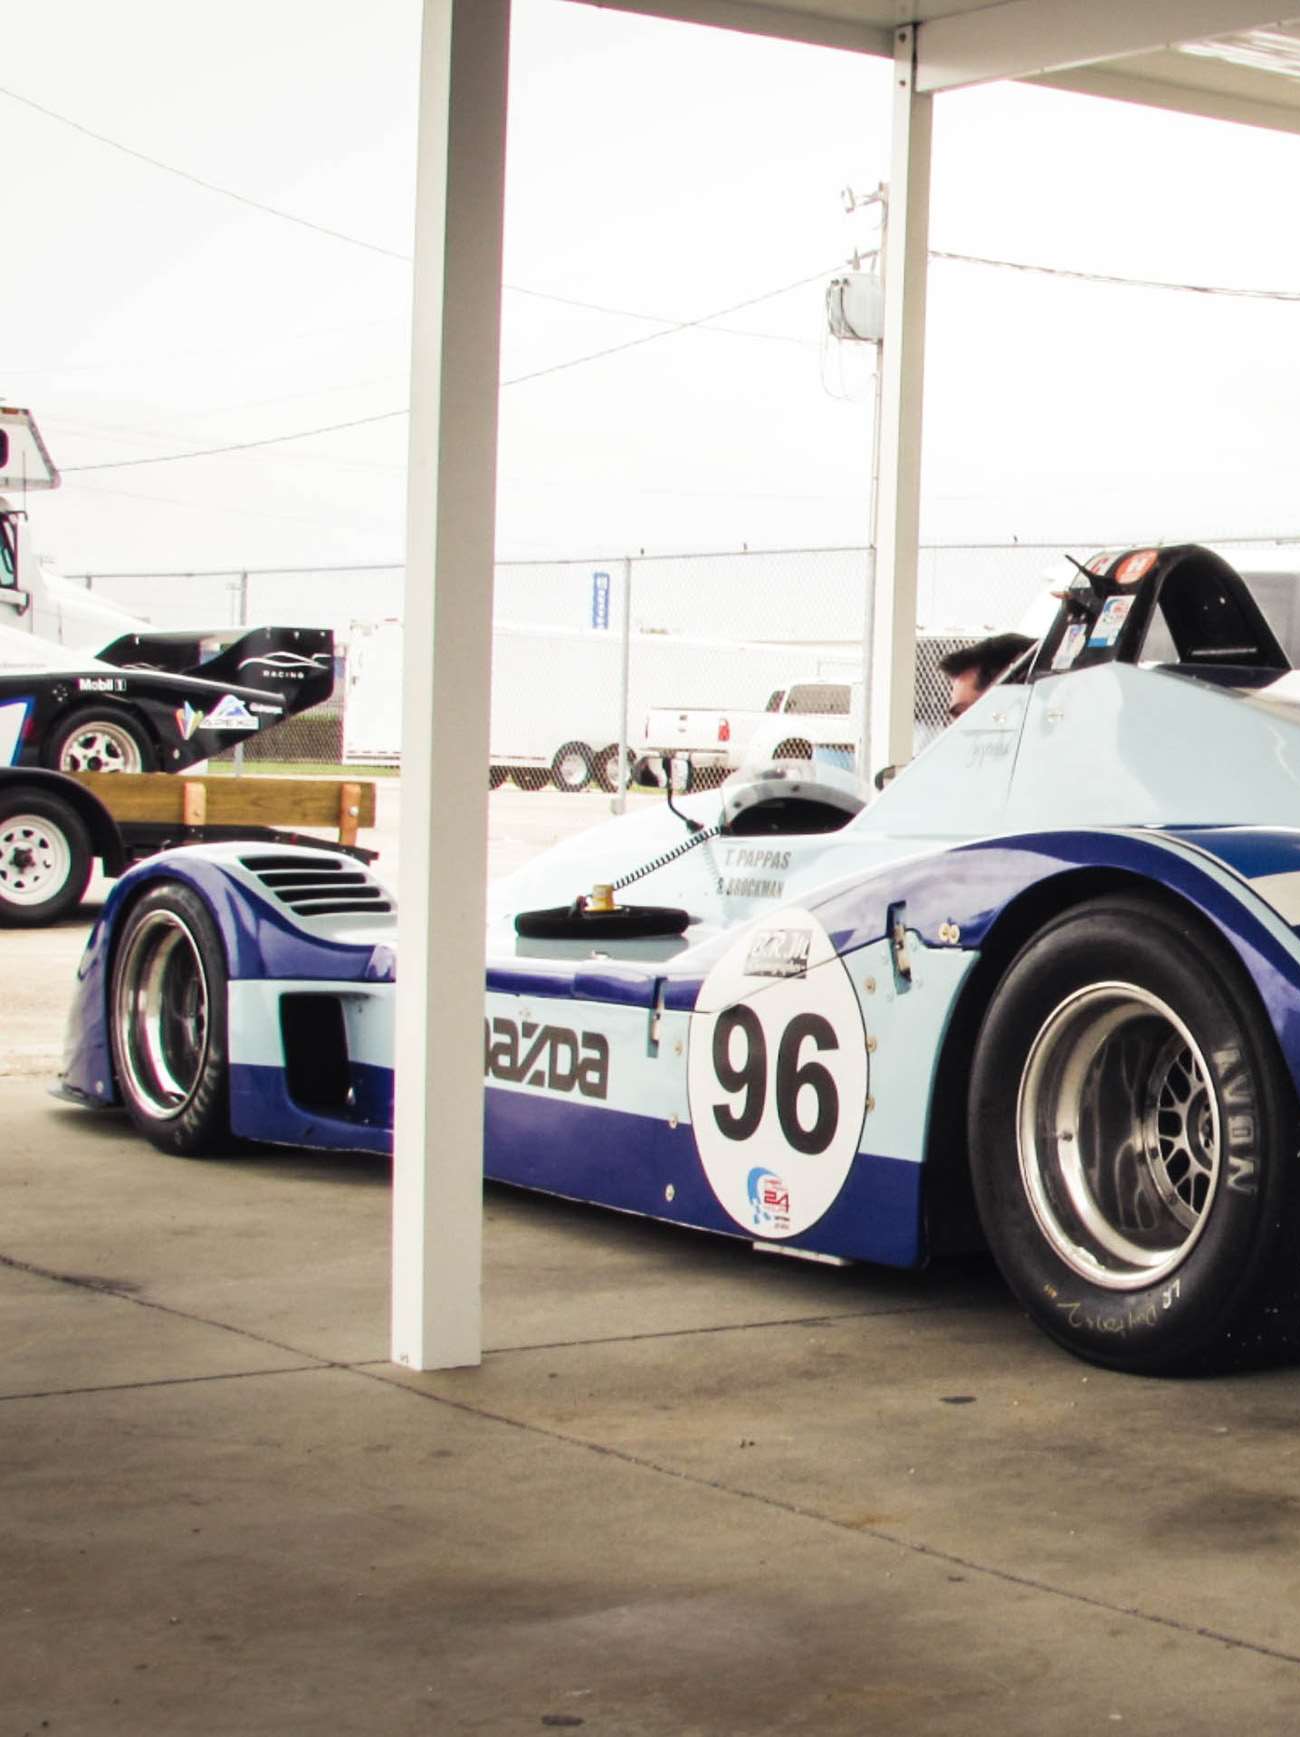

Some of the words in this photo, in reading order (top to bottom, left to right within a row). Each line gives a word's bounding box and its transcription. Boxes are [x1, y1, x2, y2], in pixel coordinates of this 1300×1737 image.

[79, 678, 114, 691] Mobil
[262, 669, 305, 679] RACING
[736, 848, 791, 869] PAPPAS
[711, 1002, 841, 1156] 96
[1213, 1047, 1257, 1194] AVON
[764, 1189, 789, 1213] 24
